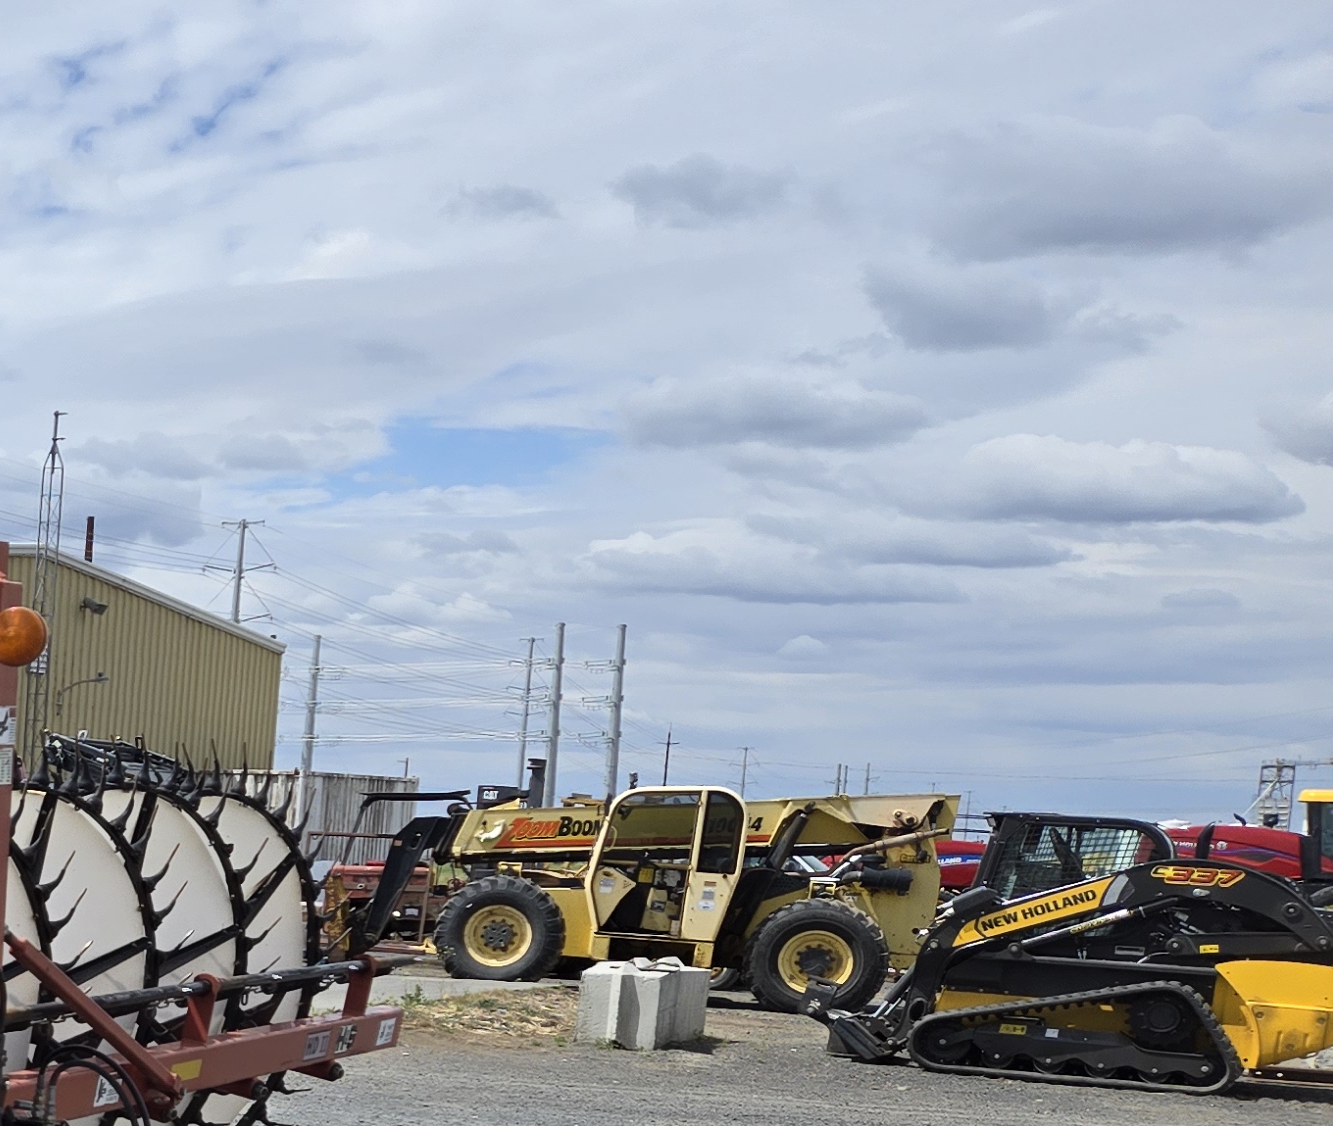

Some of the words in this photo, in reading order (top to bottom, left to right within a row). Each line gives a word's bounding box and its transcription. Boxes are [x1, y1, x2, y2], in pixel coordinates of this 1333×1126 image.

[483, 790, 499, 800] CAT
[1151, 865, 1246, 888] C337
[981, 911, 1018, 932] NEW
[1021, 889, 1097, 920] HOLLAND
